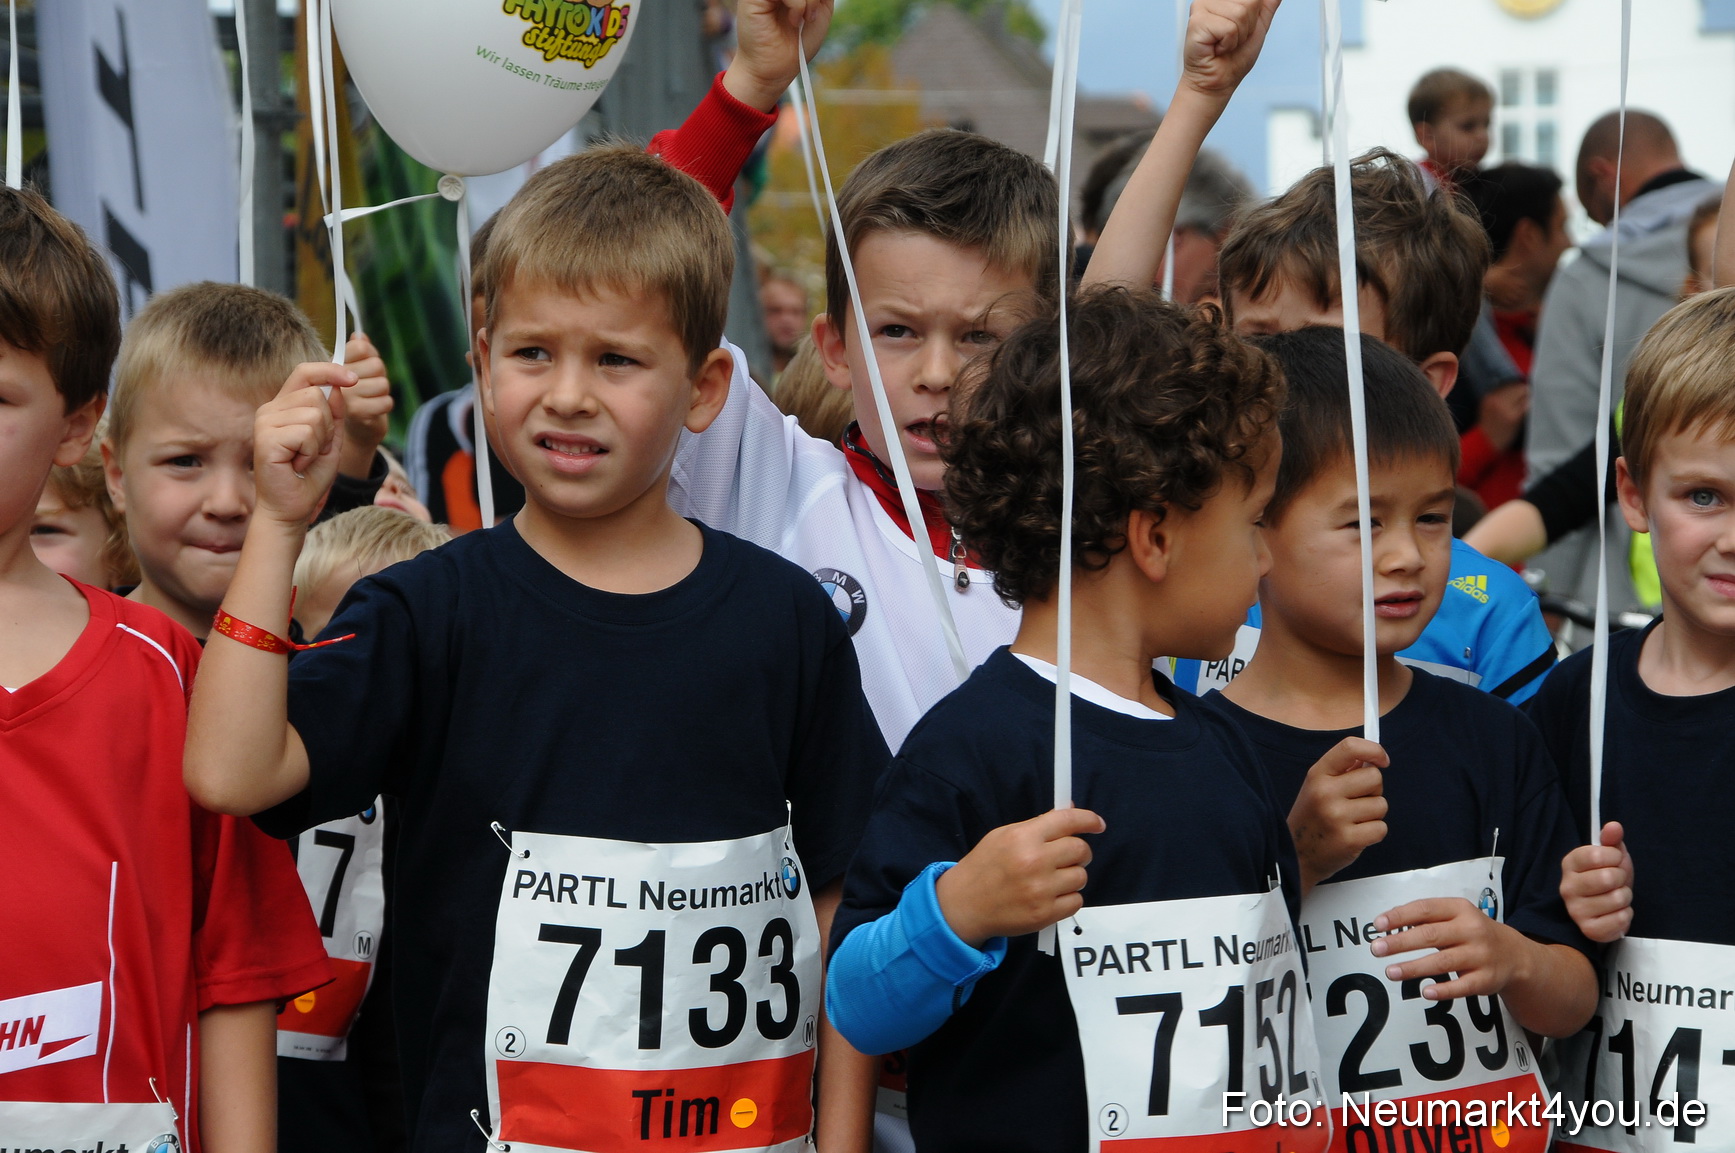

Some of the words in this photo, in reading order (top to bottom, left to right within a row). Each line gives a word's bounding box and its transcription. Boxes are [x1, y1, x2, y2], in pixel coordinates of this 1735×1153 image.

[476, 45, 500, 64] Wir
[501, 57, 541, 83] lassen
[543, 74, 583, 91] Träume
[1447, 579, 1490, 604] didas
[512, 869, 627, 909] PARTL
[639, 871, 782, 911] Neumarkt
[357, 937, 371, 955] M
[1074, 938, 1204, 977] PARTL
[537, 917, 801, 1050] 7133
[0, 1014, 47, 1051] HN
[504, 1032, 516, 1053] 2
[805, 1022, 815, 1044] M
[1115, 969, 1310, 1117] 7152
[1306, 971, 1509, 1094] 239
[1516, 1047, 1530, 1068] M
[1584, 1015, 1735, 1144] 714
[632, 1088, 720, 1141] Tim
[1108, 1110, 1119, 1132] 2
